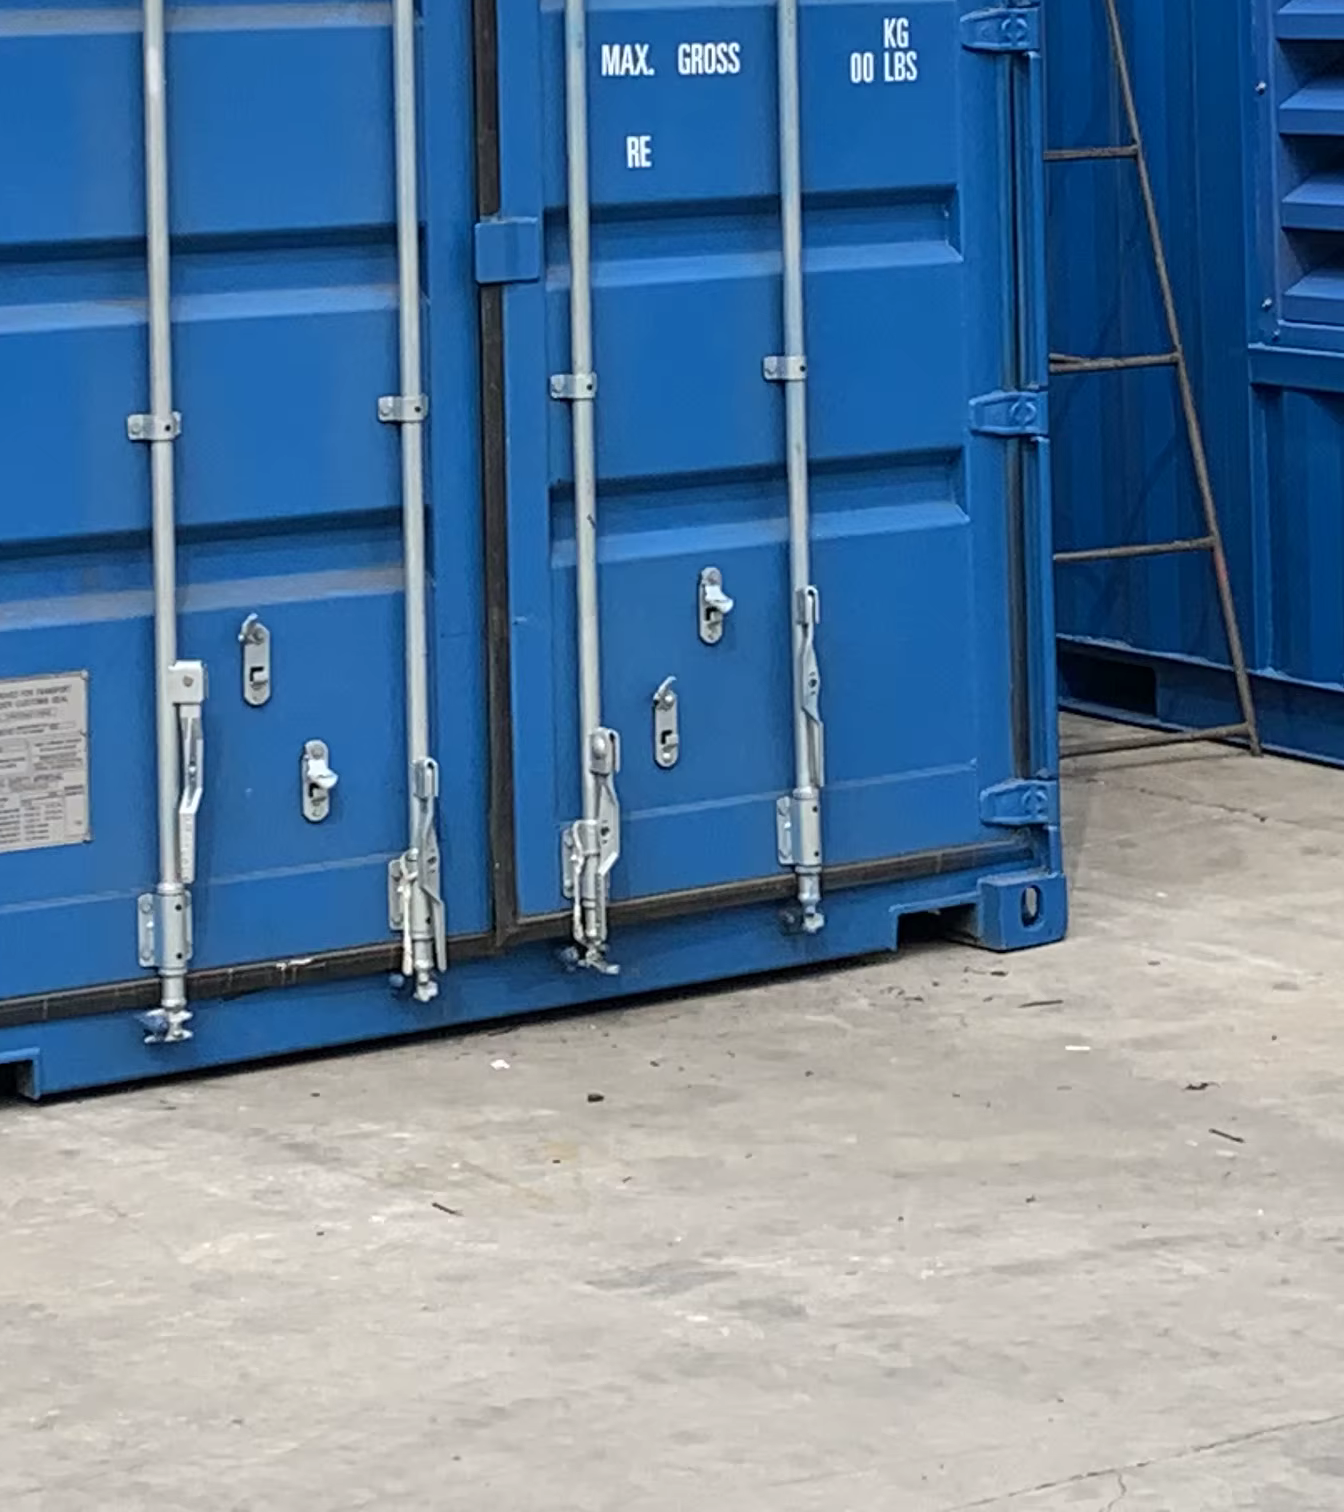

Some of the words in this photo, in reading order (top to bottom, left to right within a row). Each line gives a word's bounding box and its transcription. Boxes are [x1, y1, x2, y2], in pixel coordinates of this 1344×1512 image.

[883, 17, 909, 49] KG
[600, 43, 655, 77] MAX.
[677, 42, 741, 76] GROSS
[850, 52, 874, 84] 00
[884, 51, 918, 83] LBS
[626, 135, 652, 169] RE
